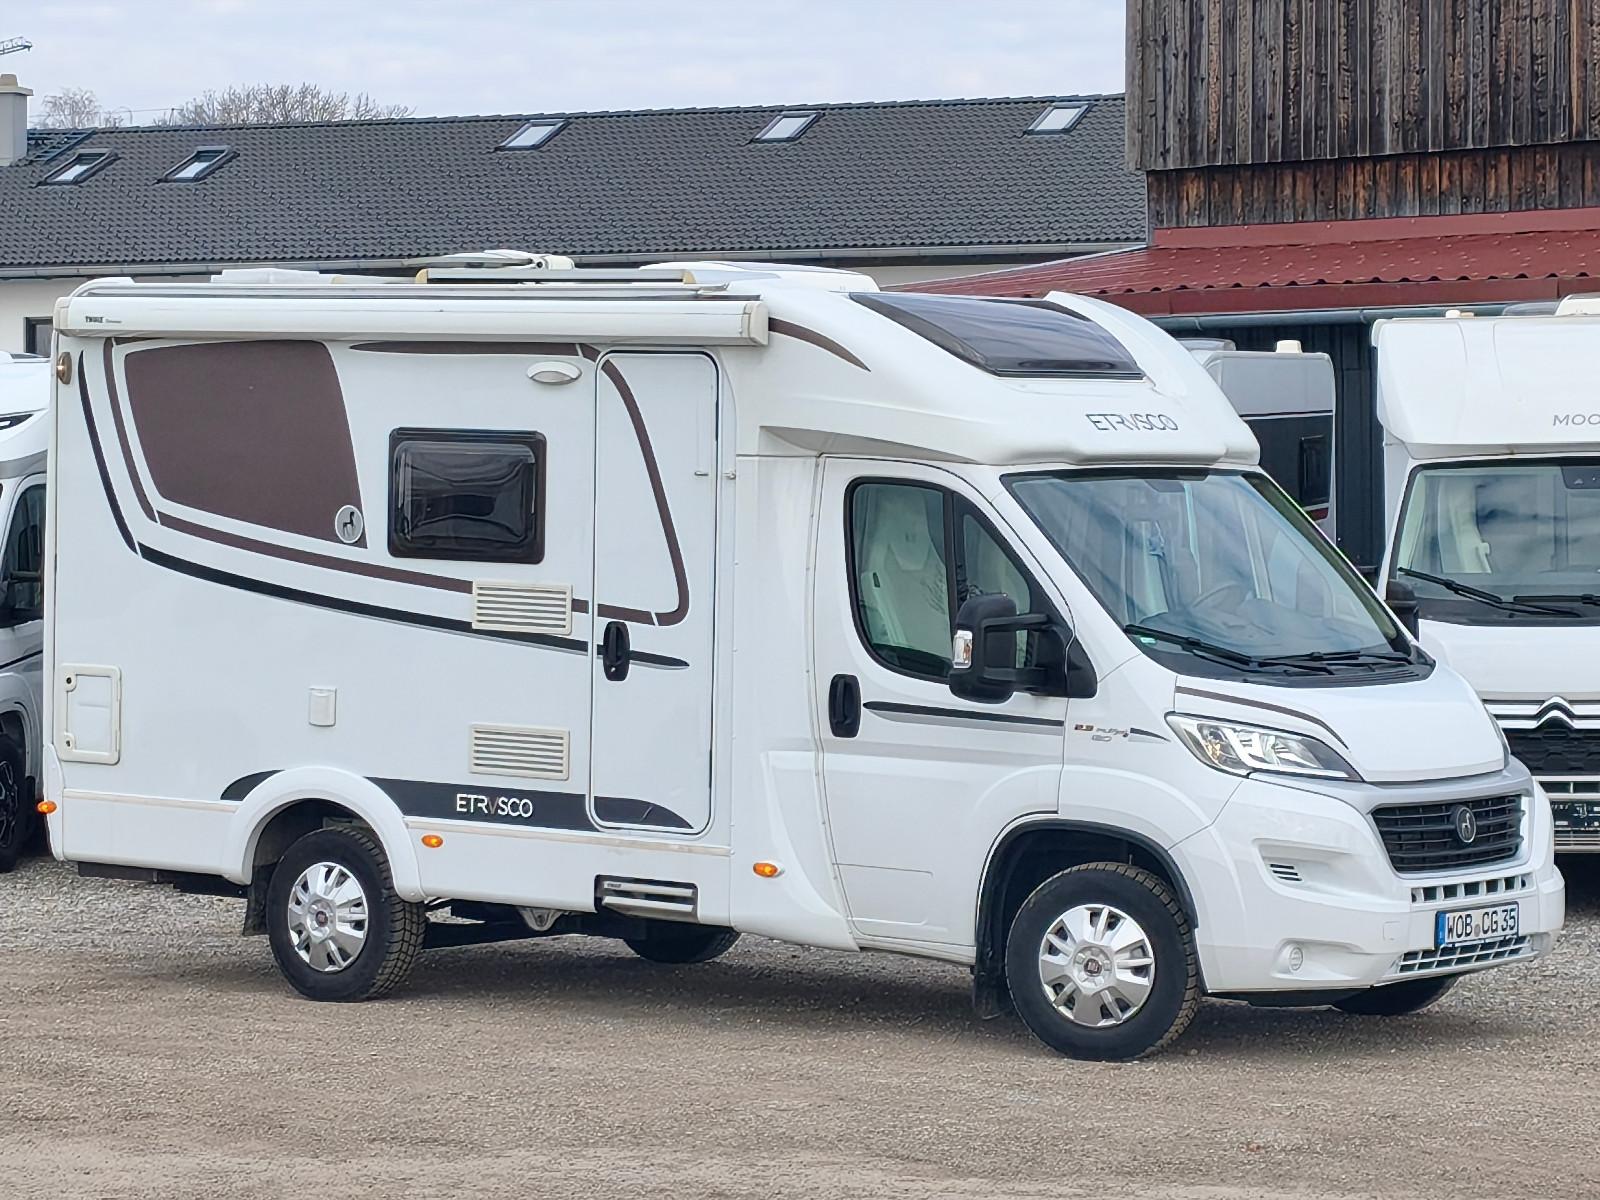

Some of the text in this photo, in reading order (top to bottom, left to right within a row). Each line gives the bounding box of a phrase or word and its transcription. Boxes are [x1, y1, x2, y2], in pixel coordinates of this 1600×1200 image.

[1447, 907, 1517, 940] WOB CG 35
